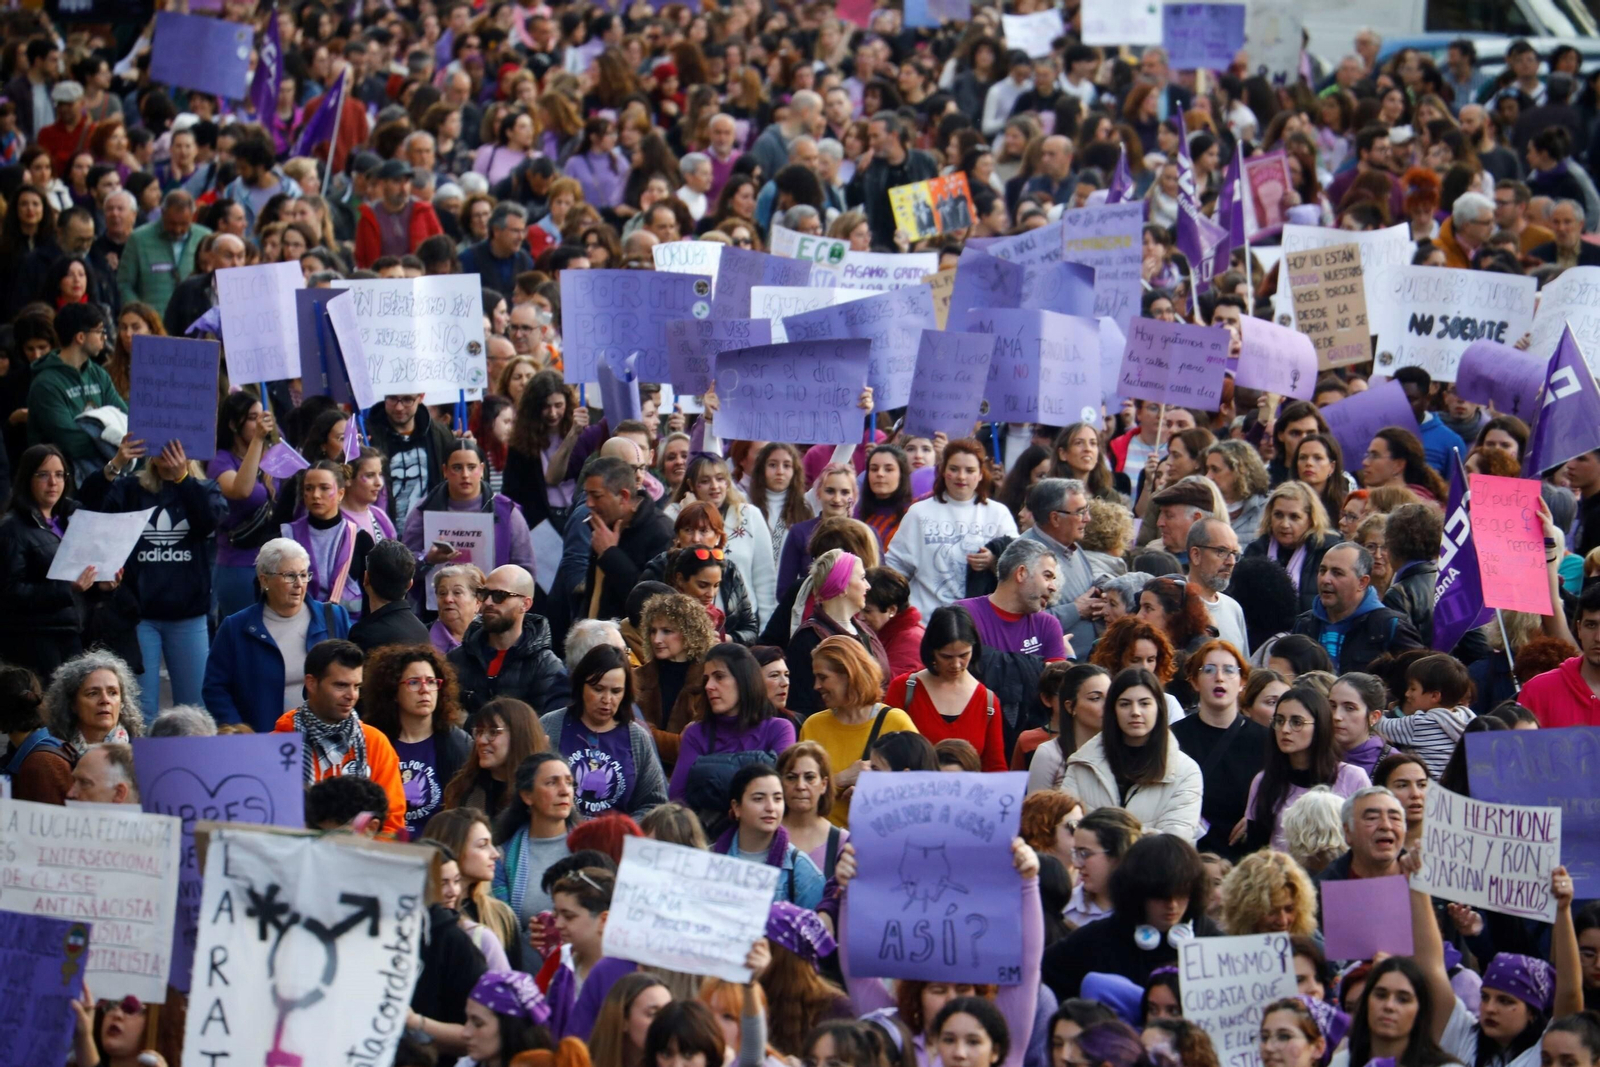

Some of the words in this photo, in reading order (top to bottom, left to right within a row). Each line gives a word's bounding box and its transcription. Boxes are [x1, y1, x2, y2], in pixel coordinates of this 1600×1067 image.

[1287, 253, 1307, 272] HOY
[574, 275, 643, 309] POR
[1297, 306, 1328, 323] DESDE
[1337, 302, 1350, 316] LA
[1336, 316, 1351, 330] NO
[1355, 313, 1367, 328] SE
[1407, 310, 1436, 337] NO
[432, 321, 466, 355] NO
[574, 312, 643, 348] POR
[1134, 325, 1154, 350] Hoy
[1161, 331, 1204, 351] gritamos
[1210, 341, 1222, 351] en
[783, 359, 799, 381] el
[1013, 363, 1030, 380] NO
[1127, 349, 1141, 365] las
[1145, 356, 1170, 371] calles
[1177, 361, 1205, 375] pero
[742, 383, 775, 409] que
[786, 384, 808, 403] no
[814, 383, 851, 407] falte
[1122, 372, 1166, 392] luchamos
[1169, 382, 1193, 396] cada
[738, 411, 847, 444] NINGUNA
[1492, 483, 1530, 509] punto
[438, 529, 450, 537] TU
[452, 529, 483, 538] MENTE
[1473, 516, 1488, 532] es
[1490, 517, 1516, 538] que
[137, 547, 192, 562] adidas
[1022, 635, 1039, 648] 8M
[405, 806, 431, 821] ODAS
[584, 799, 612, 813] TODAS
[938, 804, 950, 825] A
[1426, 784, 1453, 826] SIN
[1464, 800, 1559, 845] HERMIONE
[29, 812, 93, 840] LUCHA
[96, 816, 173, 849] FEMINISTA
[1484, 839, 1496, 870] Y
[1501, 841, 1543, 876] RON
[1487, 873, 1551, 913] MUERTOS
[877, 902, 990, 968] ASÍ?
[1183, 941, 1215, 982] EL
[1217, 950, 1274, 978] MISMO
[1184, 984, 1247, 1013] CUBATA
